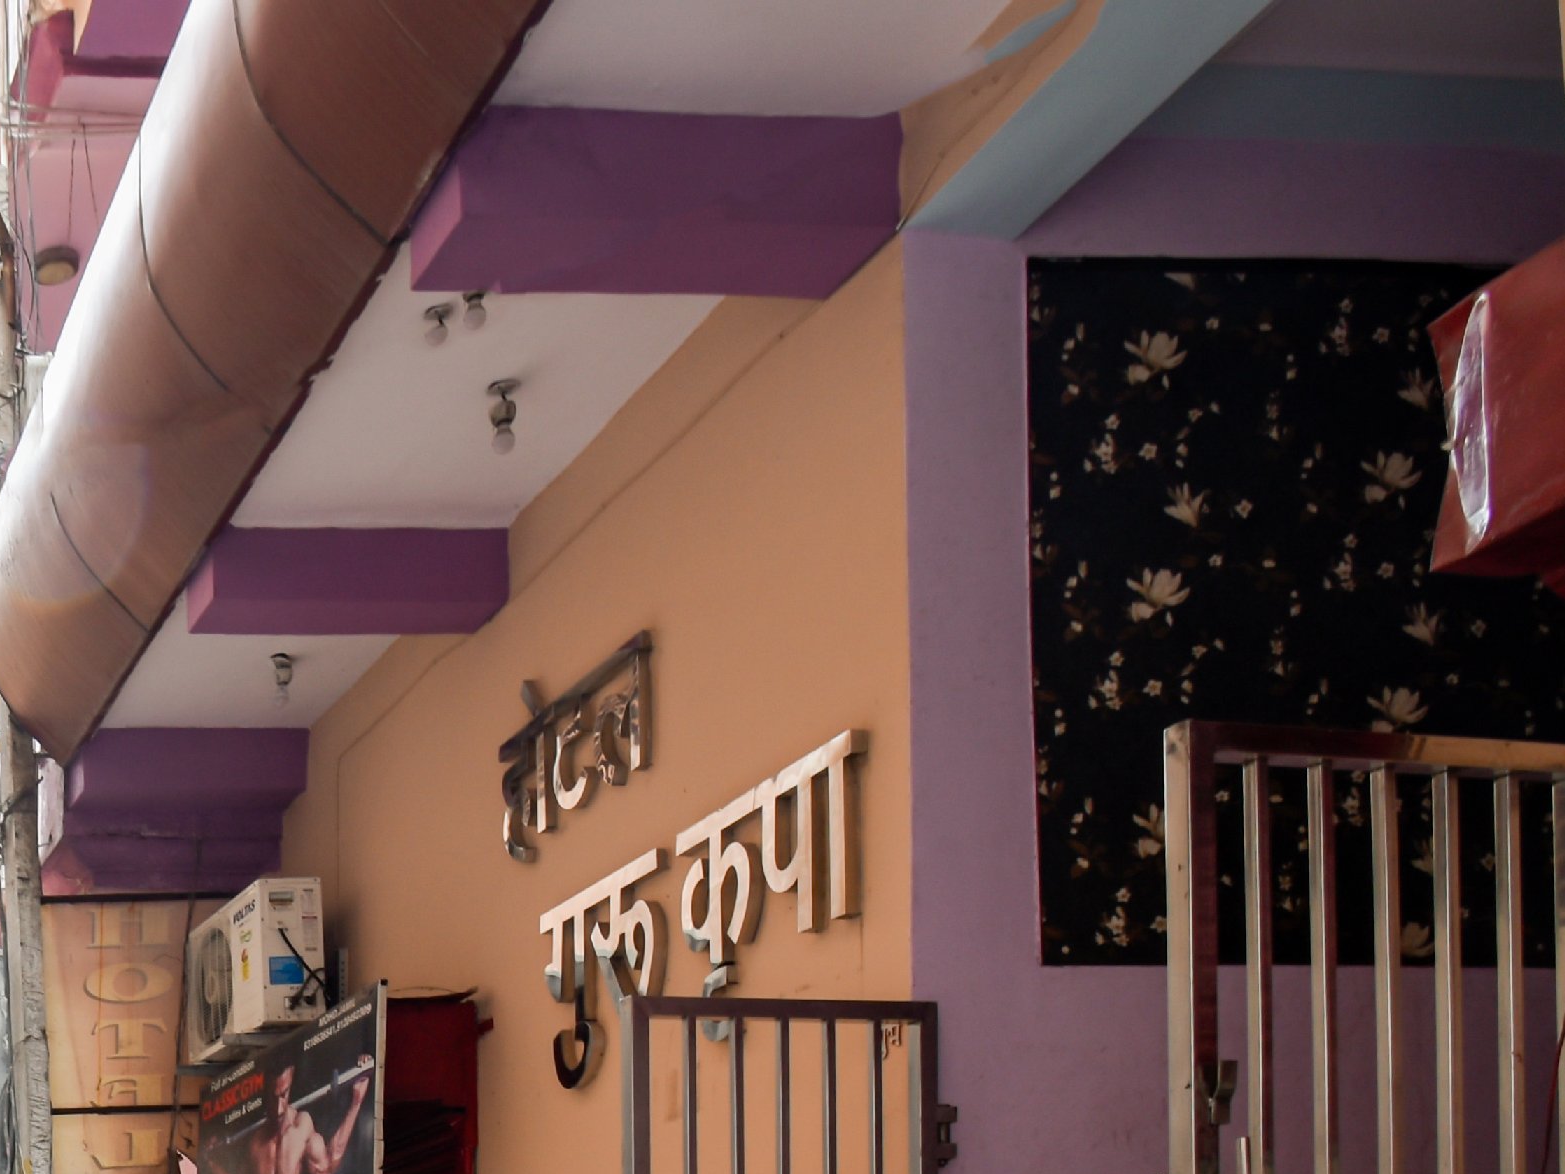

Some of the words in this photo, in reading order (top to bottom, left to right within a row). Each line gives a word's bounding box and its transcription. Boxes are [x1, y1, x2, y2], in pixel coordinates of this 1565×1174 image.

[499, 629, 653, 863] होटल
[233, 899, 256, 925] VOLTAS
[202, 1083, 240, 1121] CLASSIC
[240, 1072, 265, 1100] GYM
